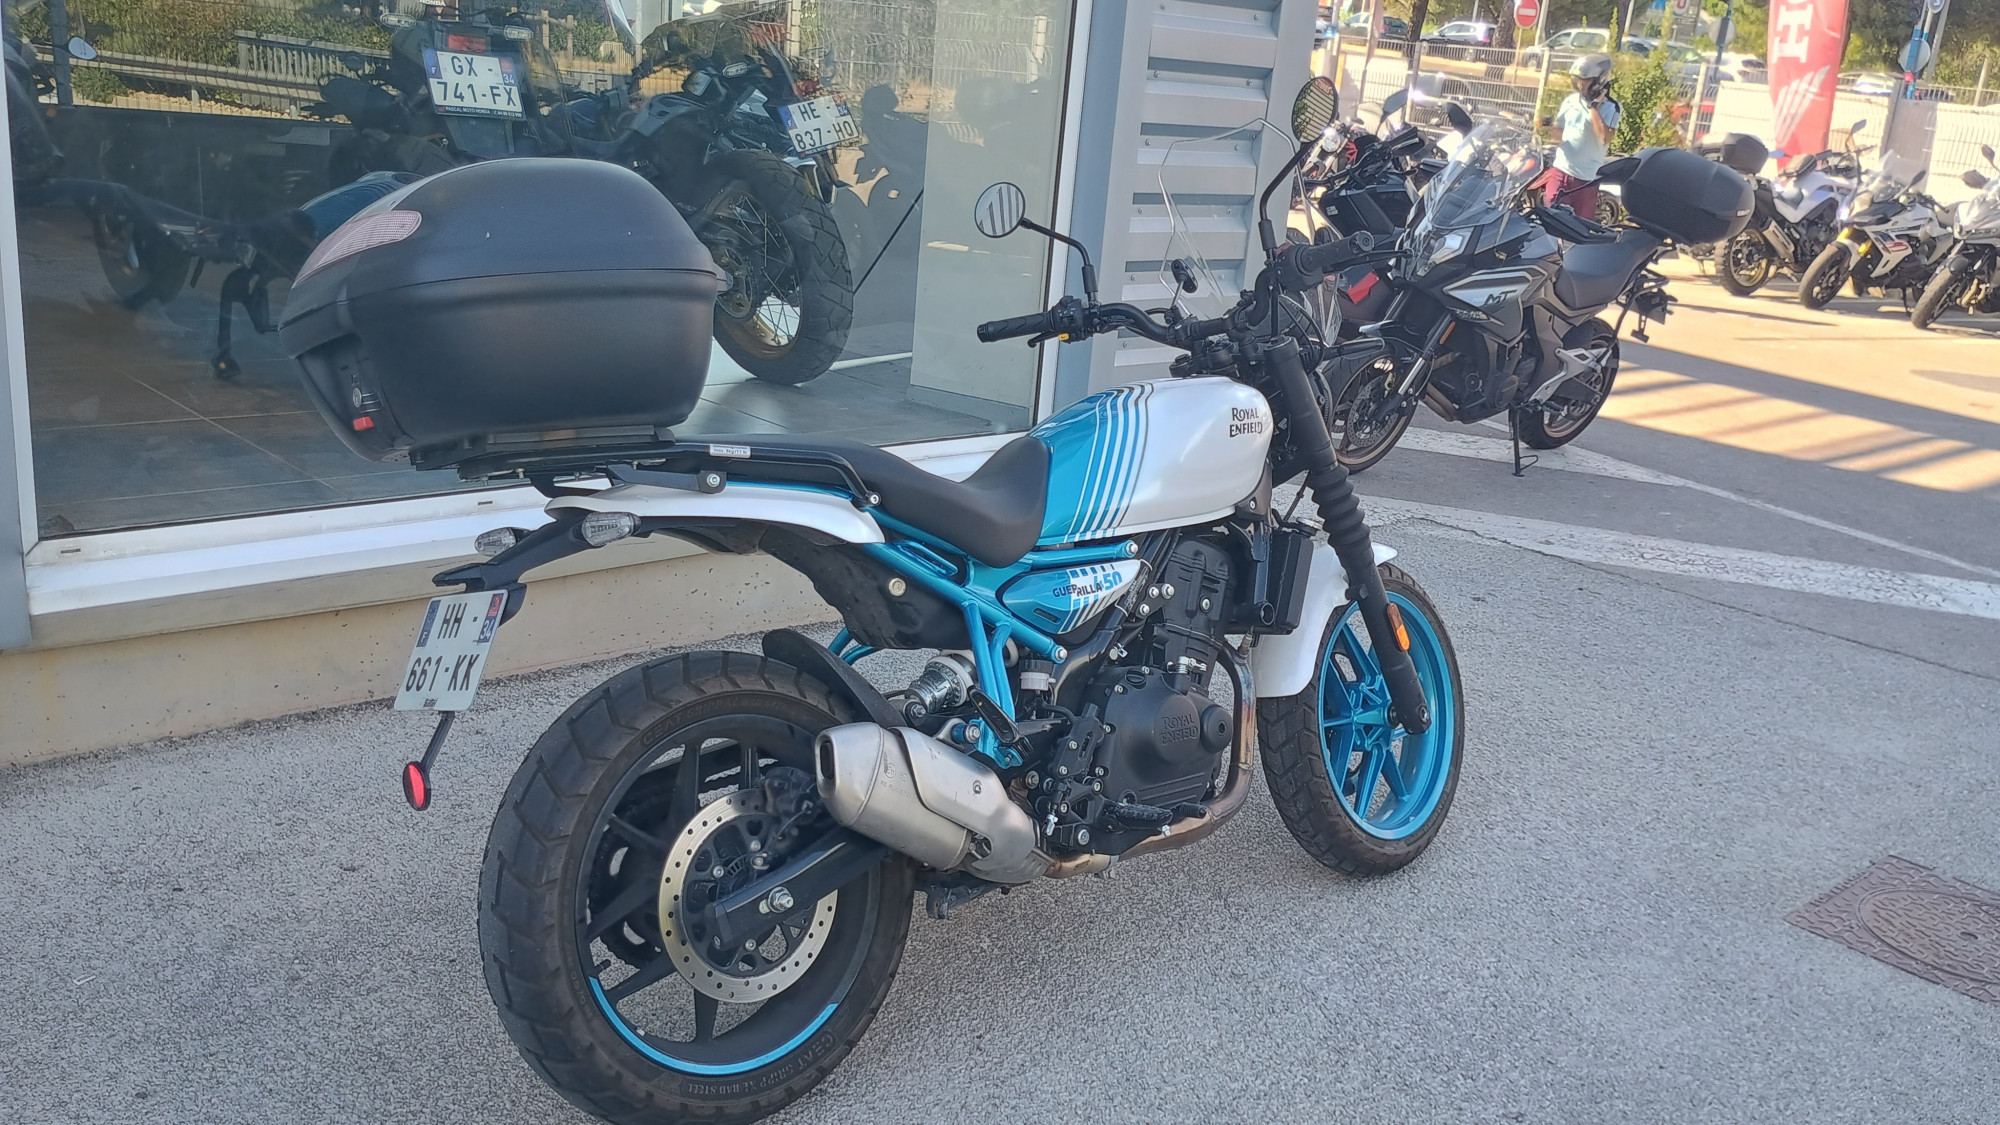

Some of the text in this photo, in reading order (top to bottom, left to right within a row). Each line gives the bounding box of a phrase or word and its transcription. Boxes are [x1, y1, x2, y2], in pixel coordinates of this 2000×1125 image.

[1771, 0, 1814, 64] H
[450, 55, 479, 77] GX
[503, 73, 515, 84] 34
[436, 81, 517, 107] 741-FX
[797, 101, 821, 122] HE
[1231, 407, 1260, 422] ROYAL
[1229, 421, 1263, 438] ENFIELD
[1052, 583, 1103, 598] GUERRILLA
[437, 602, 468, 640] HH
[480, 619, 494, 640] 34
[405, 653, 480, 692] 661-KK
[1161, 714, 1195, 730] ROYAL
[1160, 726, 1199, 747] ENFIELD
[688, 1083, 718, 1095] STEEL
